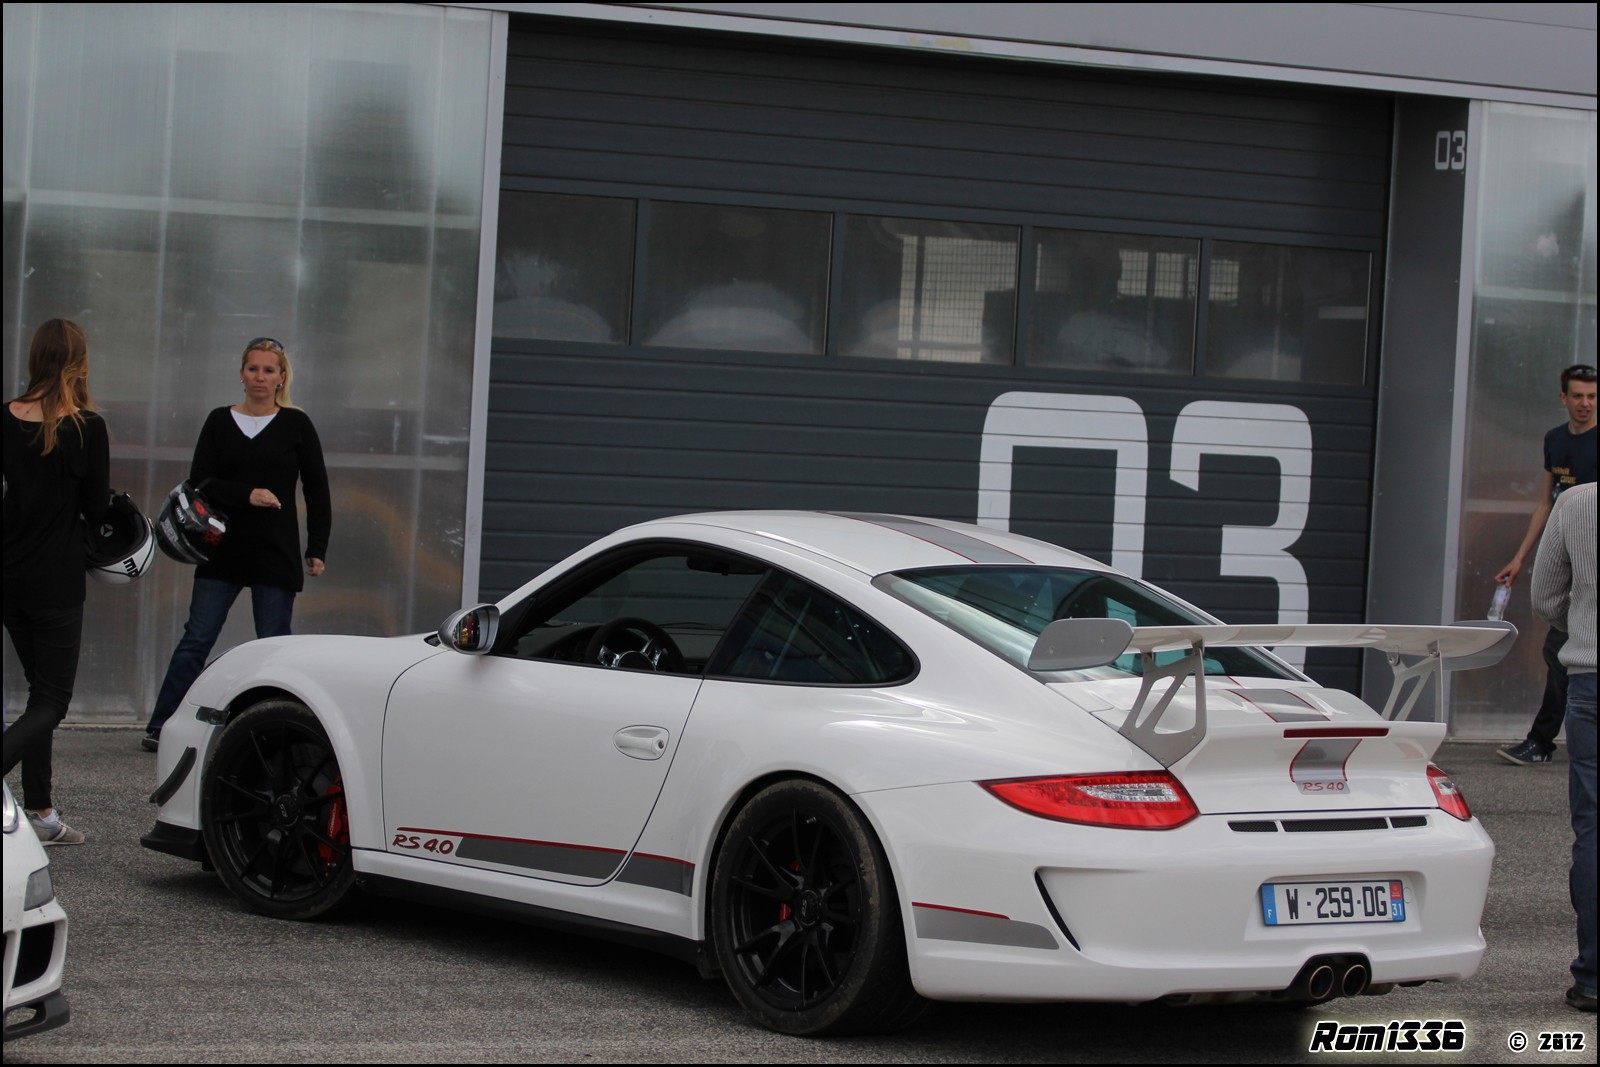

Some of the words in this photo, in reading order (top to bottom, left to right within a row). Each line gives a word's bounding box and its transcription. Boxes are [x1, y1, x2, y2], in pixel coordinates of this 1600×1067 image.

[1435, 130, 1466, 170] 03
[1303, 782, 1324, 792] RS
[392, 834, 421, 849] RS
[423, 838, 454, 855] 4.0
[1391, 903, 1403, 917] 31
